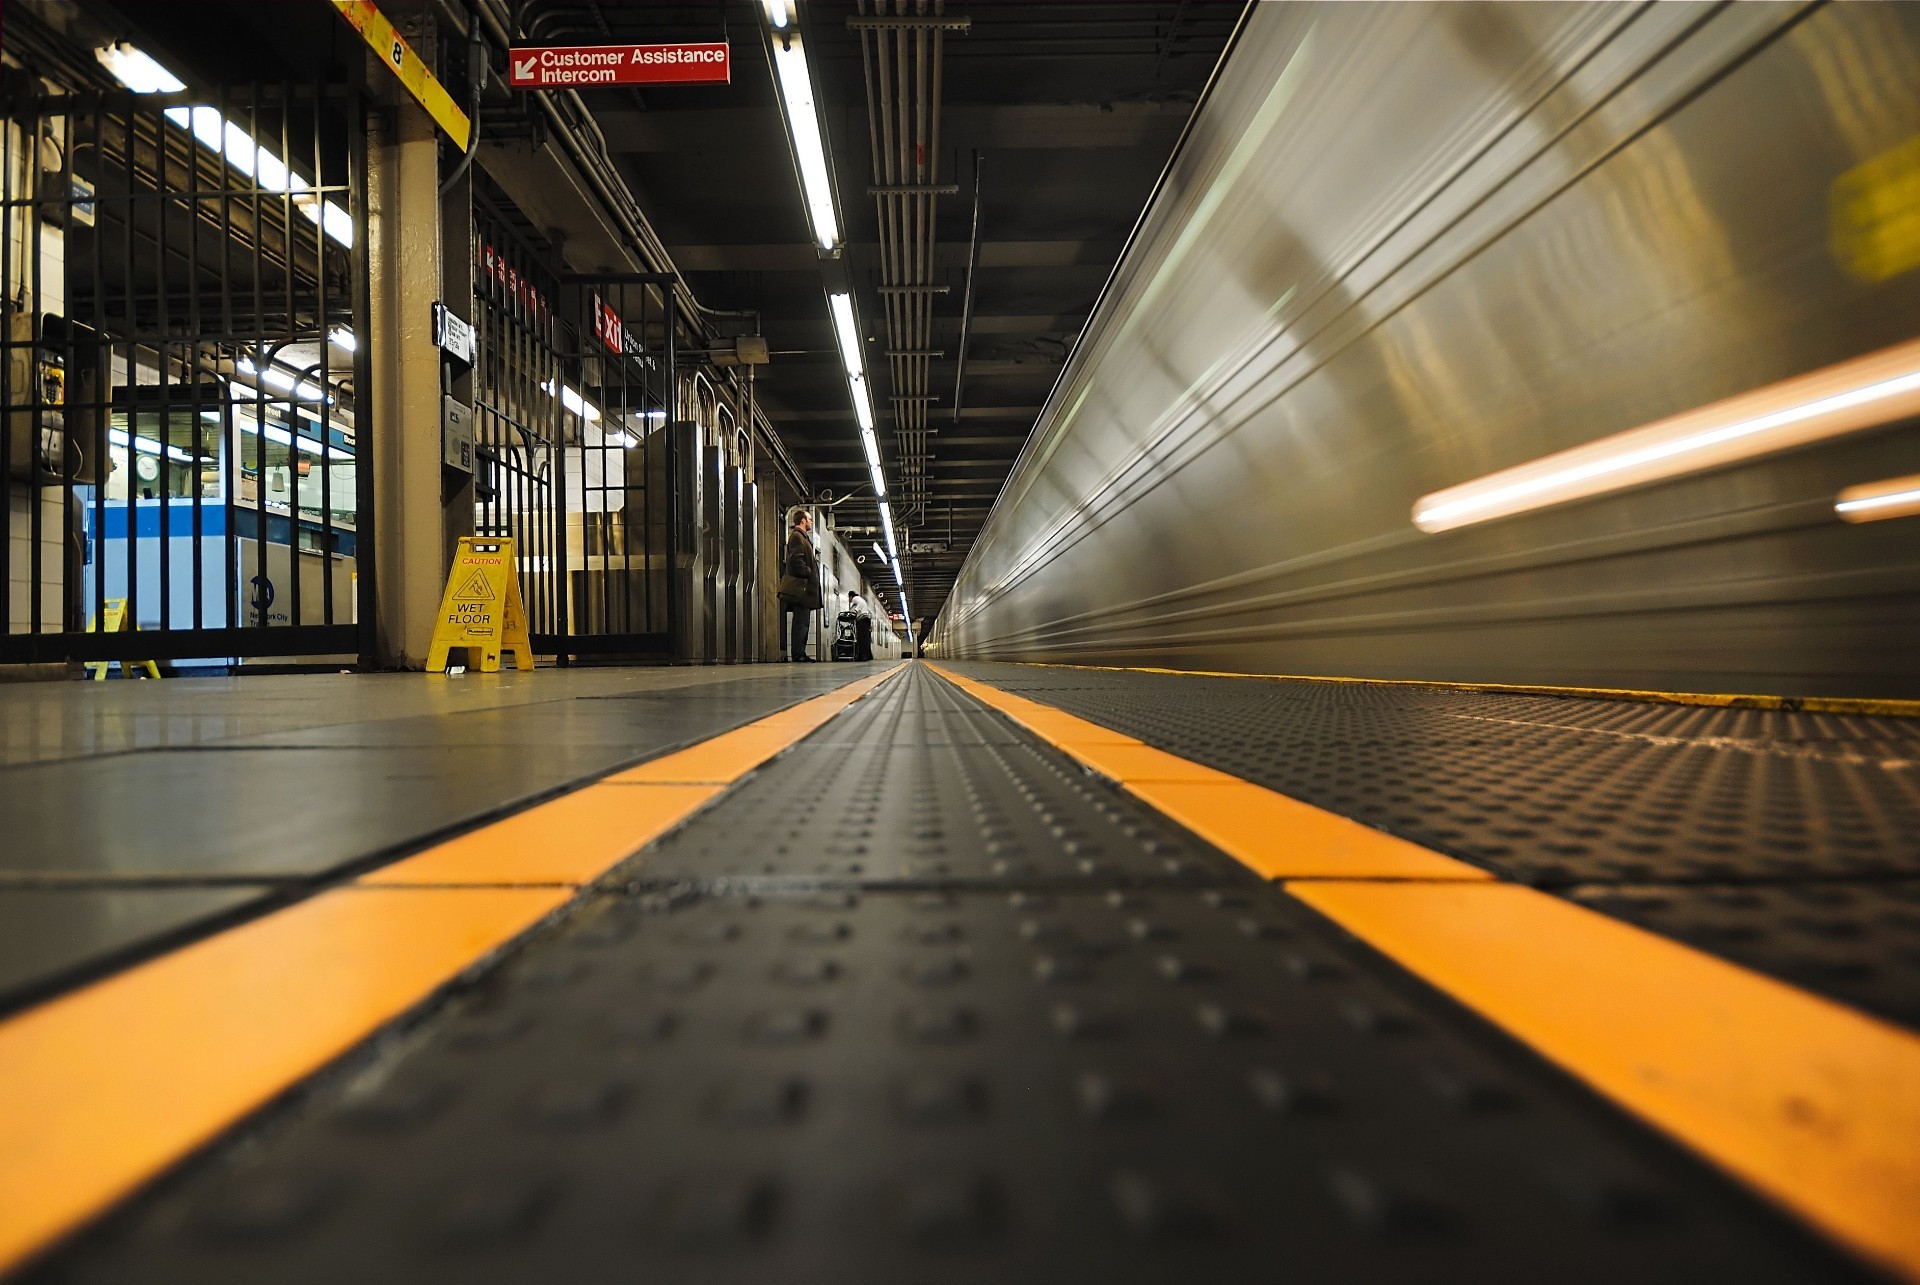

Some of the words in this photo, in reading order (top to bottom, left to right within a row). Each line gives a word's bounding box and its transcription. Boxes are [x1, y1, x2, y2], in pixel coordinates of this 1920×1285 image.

[392, 41, 402, 65] 8
[540, 50, 625, 67] Customer
[630, 48, 725, 64] Assistance
[541, 67, 616, 83] Intercom
[594, 293, 622, 353] Exit
[462, 557, 502, 565] CAUTION
[457, 603, 486, 613] WET
[277, 613, 288, 622] City
[448, 614, 491, 624] FLOOR
